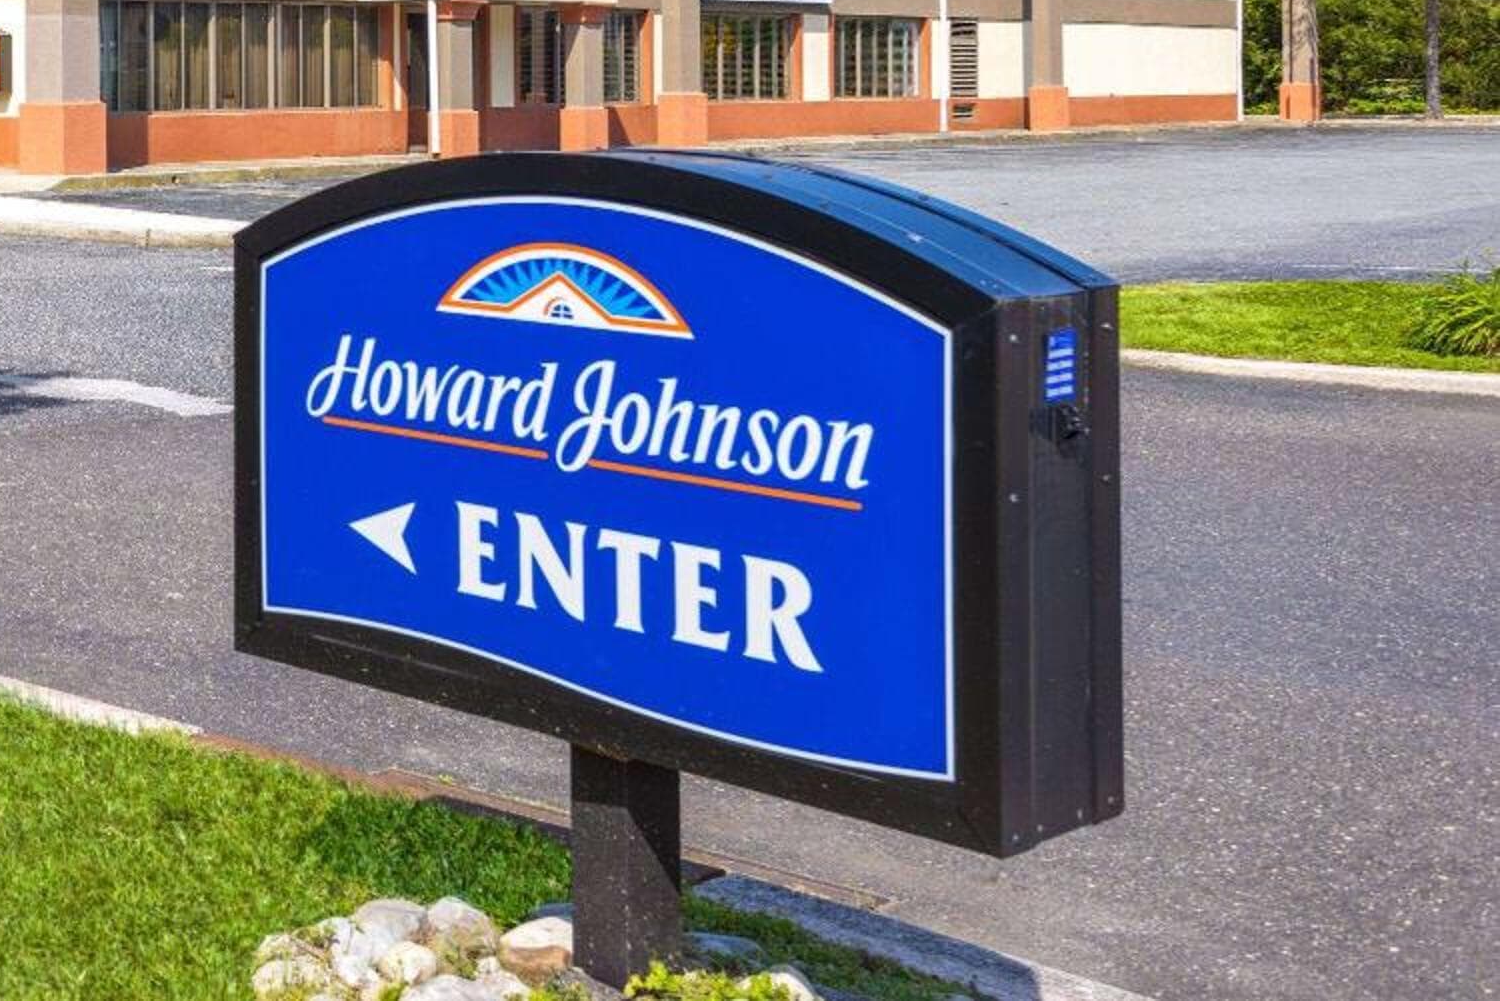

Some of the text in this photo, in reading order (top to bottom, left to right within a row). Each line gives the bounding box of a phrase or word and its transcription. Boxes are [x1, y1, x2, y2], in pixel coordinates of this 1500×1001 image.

[306, 334, 875, 490] Howard Johnson
[454, 500, 825, 674] ENTER
